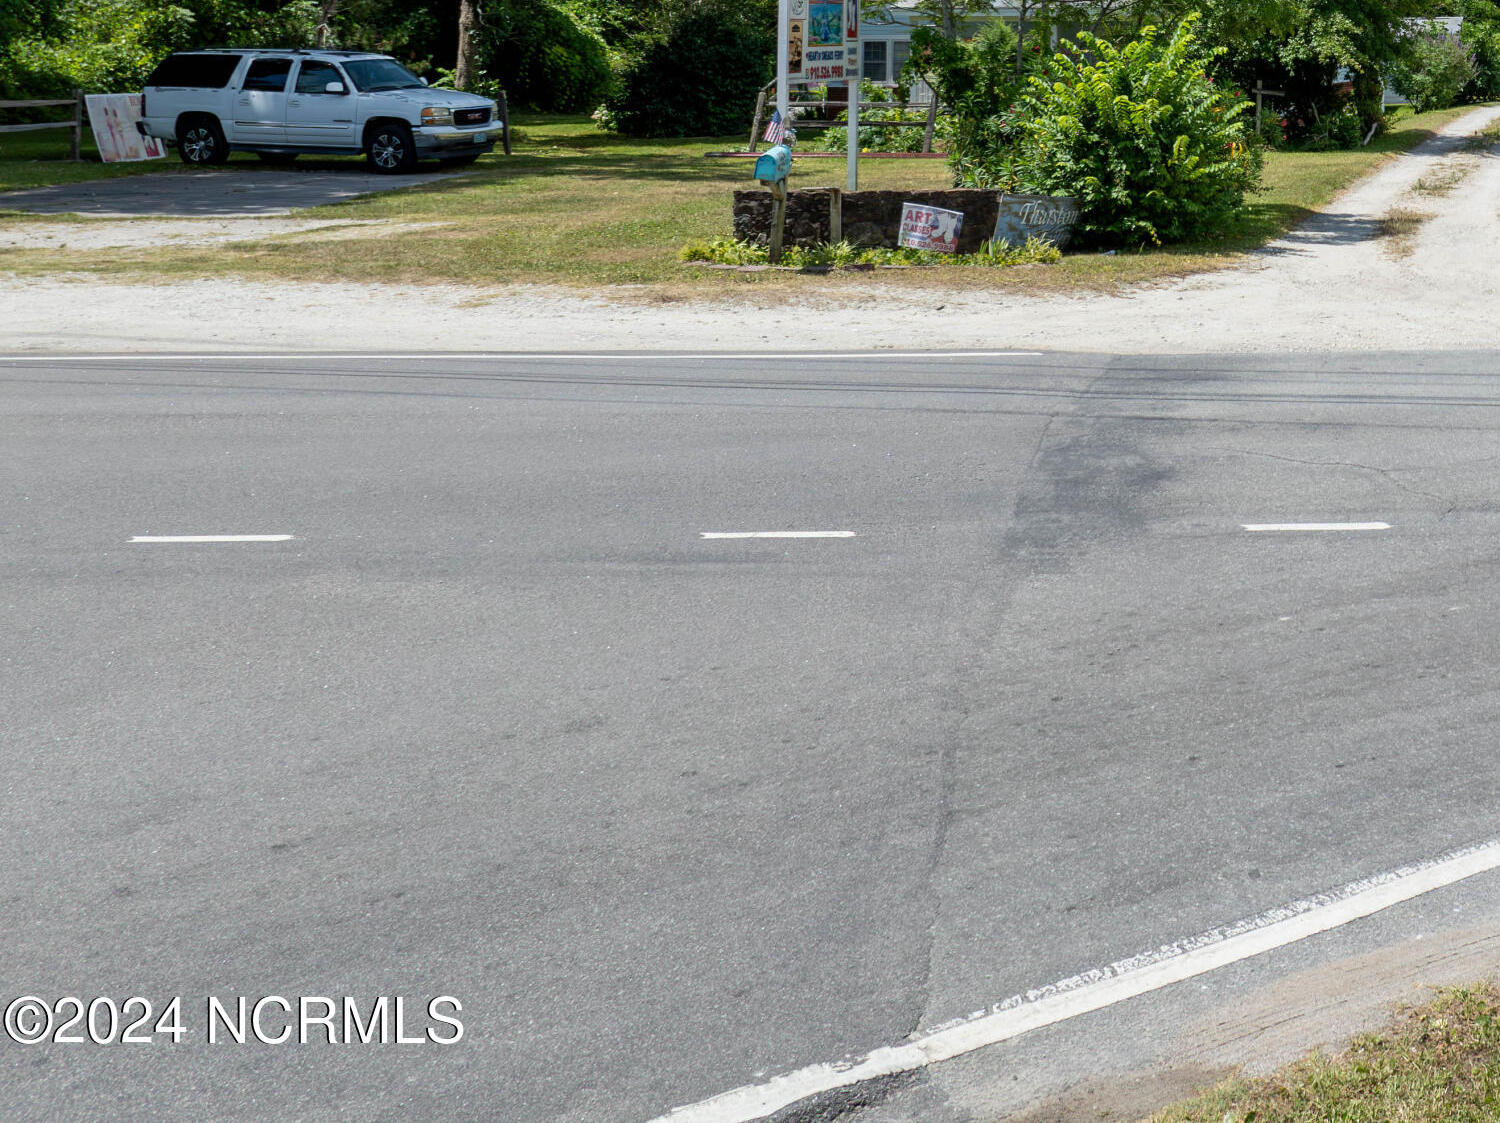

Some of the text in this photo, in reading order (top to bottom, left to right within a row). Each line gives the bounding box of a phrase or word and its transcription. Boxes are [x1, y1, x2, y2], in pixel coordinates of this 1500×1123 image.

[904, 209, 933, 225] ART
[1019, 200, 1080, 225] Thurston
[903, 222, 932, 235] CLASSES
